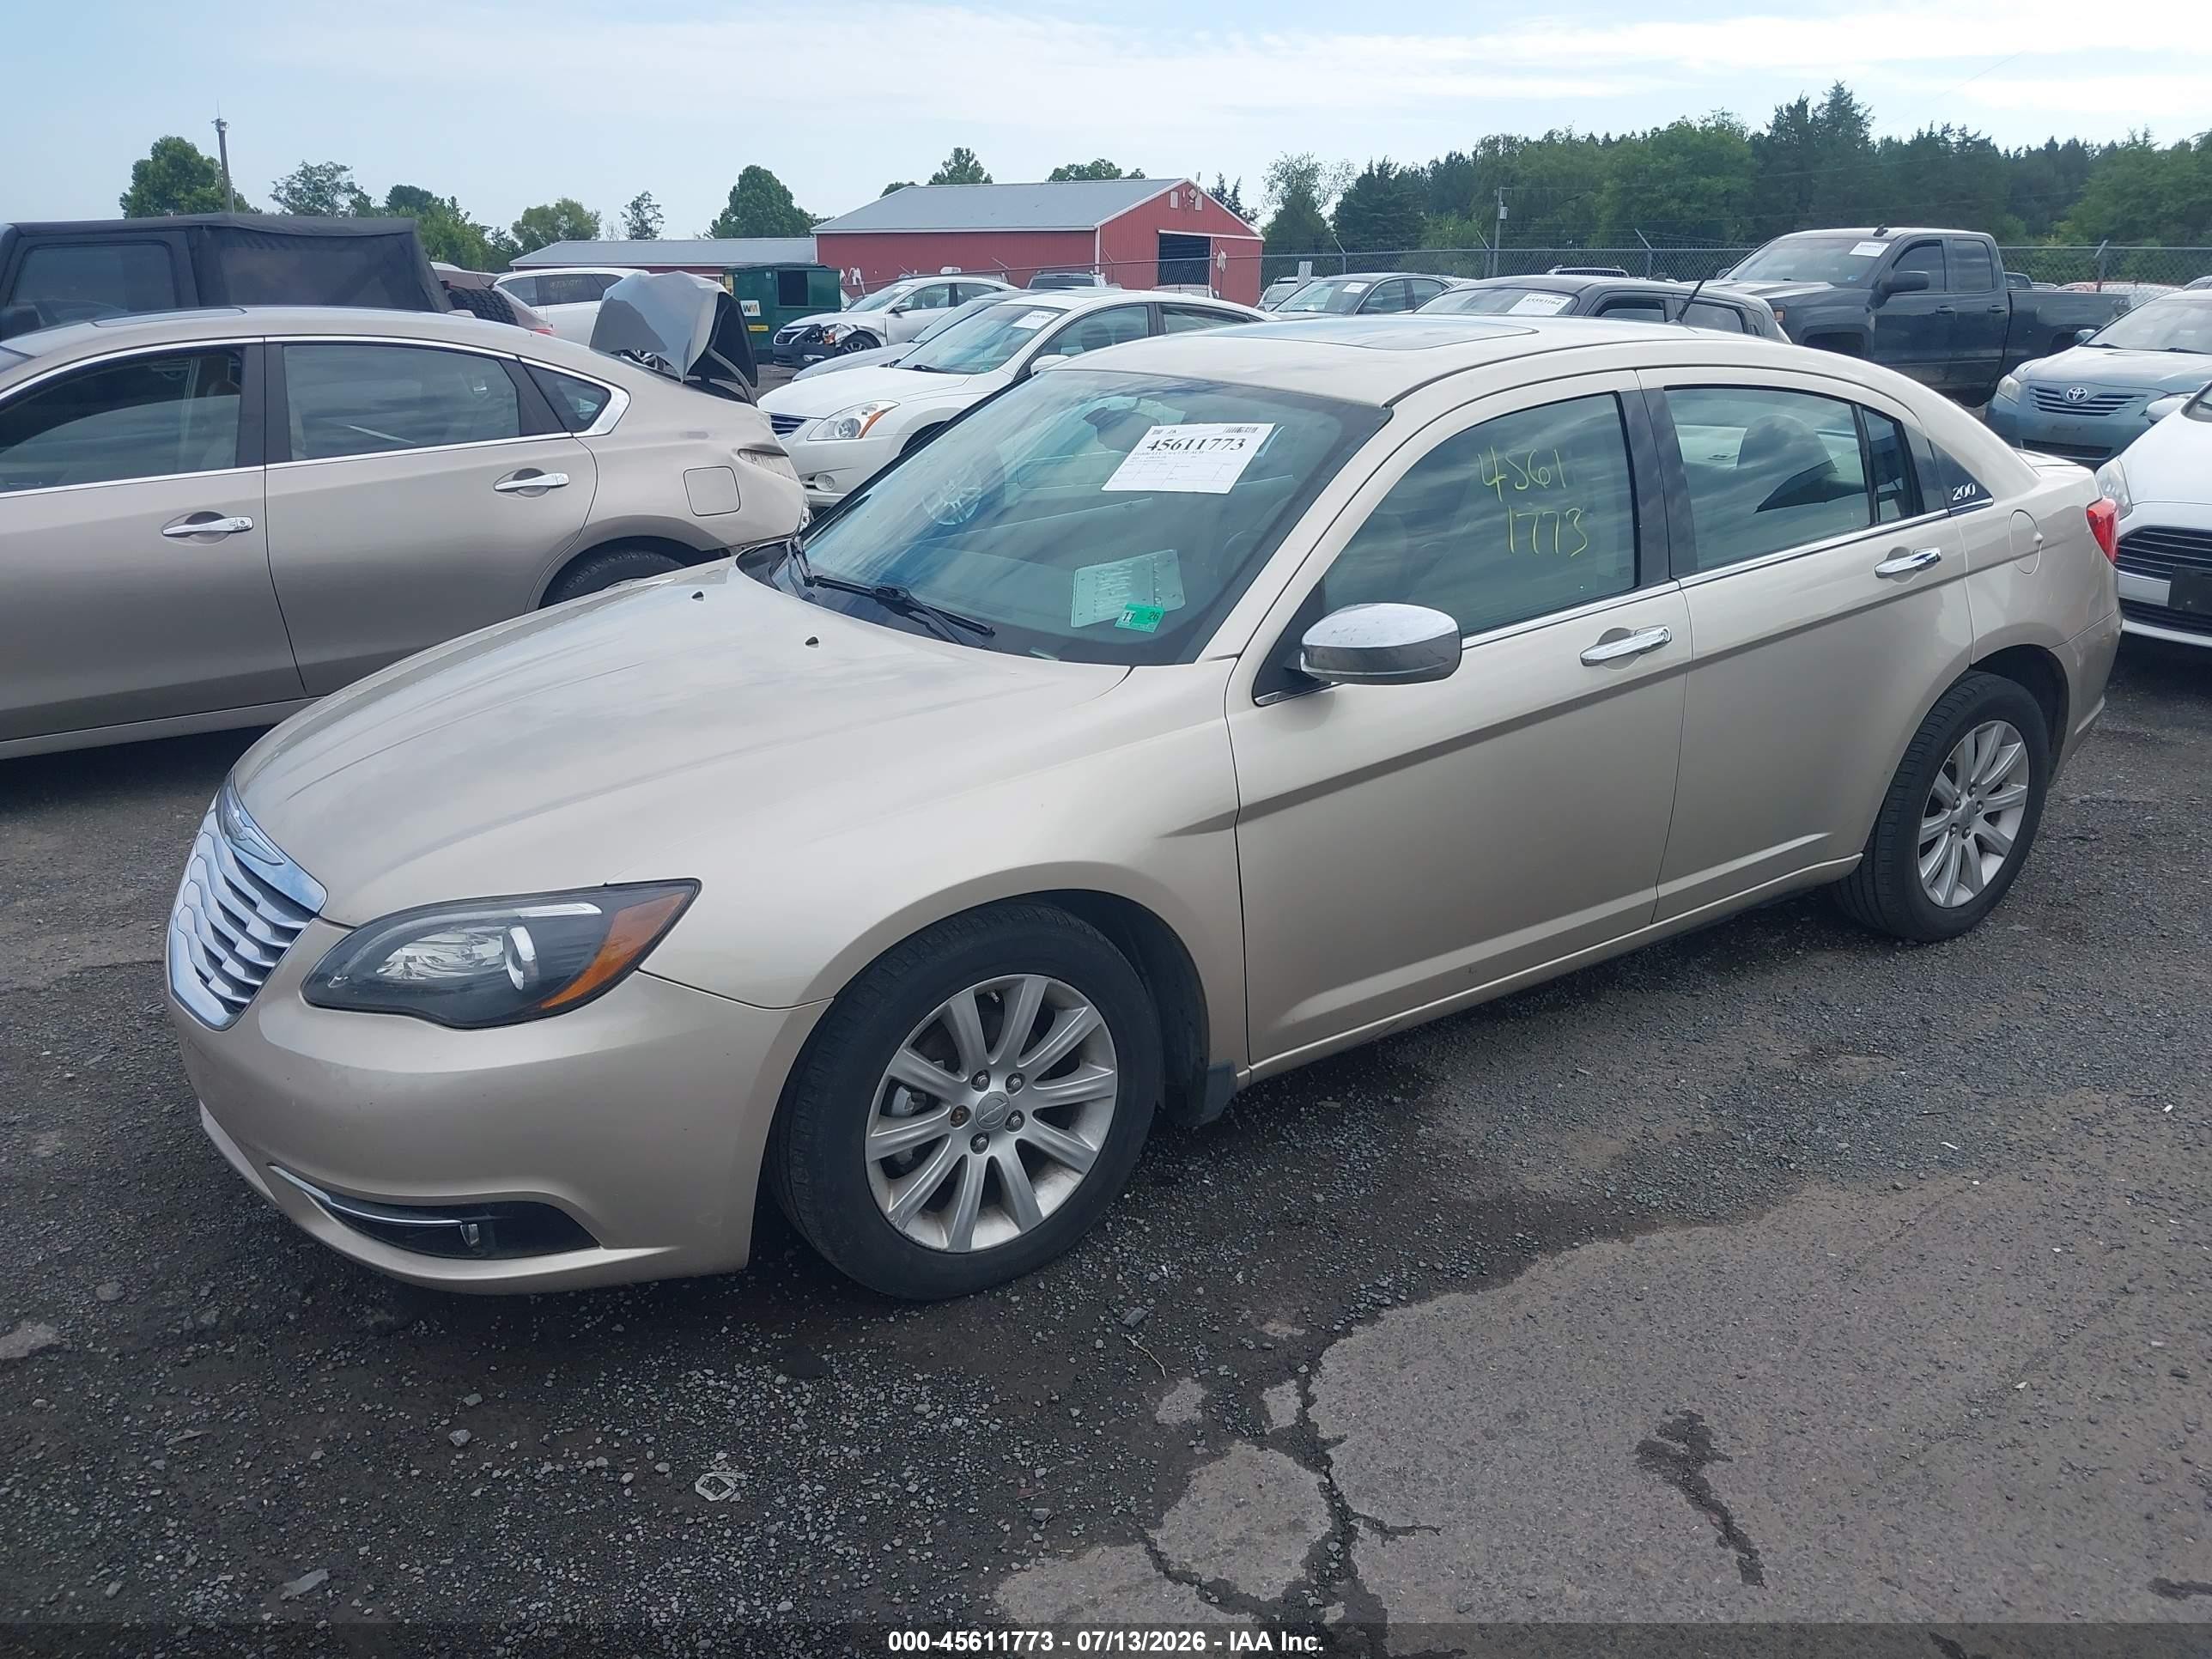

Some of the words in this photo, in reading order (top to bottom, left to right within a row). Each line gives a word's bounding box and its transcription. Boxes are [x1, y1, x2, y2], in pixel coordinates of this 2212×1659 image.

[1146, 437, 1247, 452] 45611773
[1477, 446, 1567, 502] 4561
[1952, 483, 1976, 501] 200
[1507, 504, 1588, 557] 1773
[1122, 611, 1135, 623] 11
[1147, 611, 1161, 622] 26
